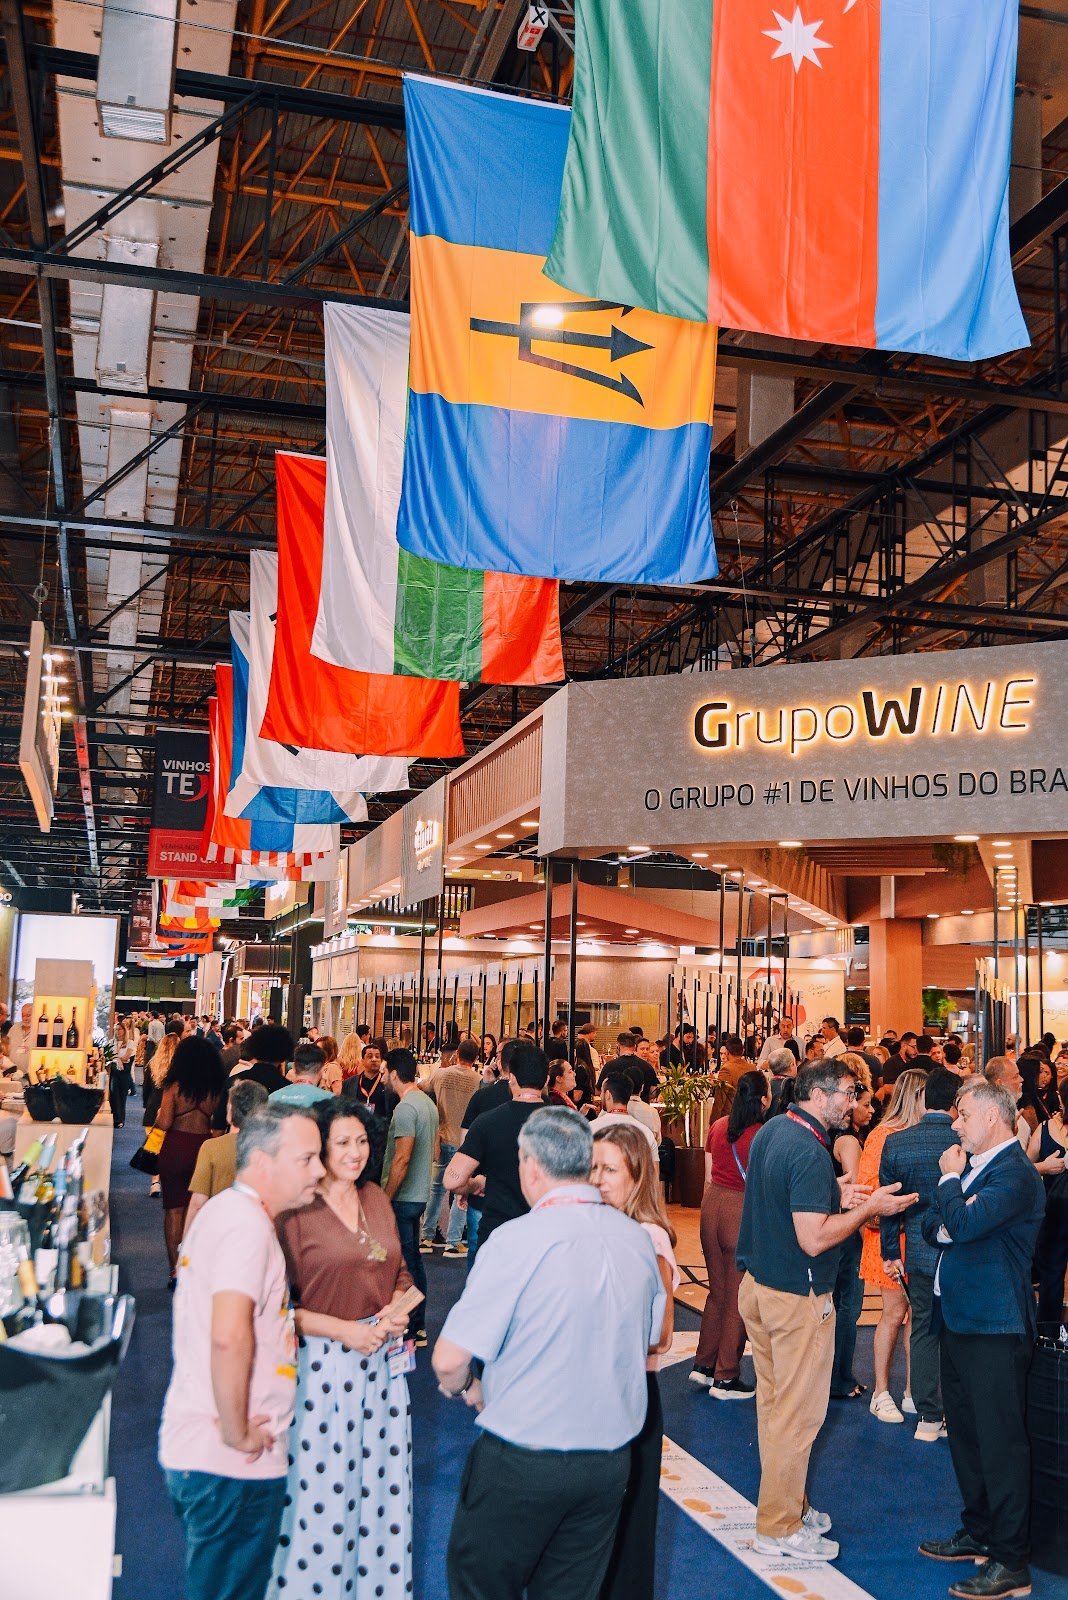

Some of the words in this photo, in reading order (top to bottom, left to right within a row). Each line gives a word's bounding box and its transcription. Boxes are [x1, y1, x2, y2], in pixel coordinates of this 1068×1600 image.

[162, 759, 211, 773] VINHOS
[645, 789, 660, 811] O
[670, 784, 754, 810] GRUPO
[763, 781, 791, 805] #1
[800, 779, 834, 803] DE
[843, 773, 948, 801] VINHOS
[958, 771, 998, 796] DO
[1010, 768, 1068, 794] BRA
[159, 851, 198, 863] STAND
